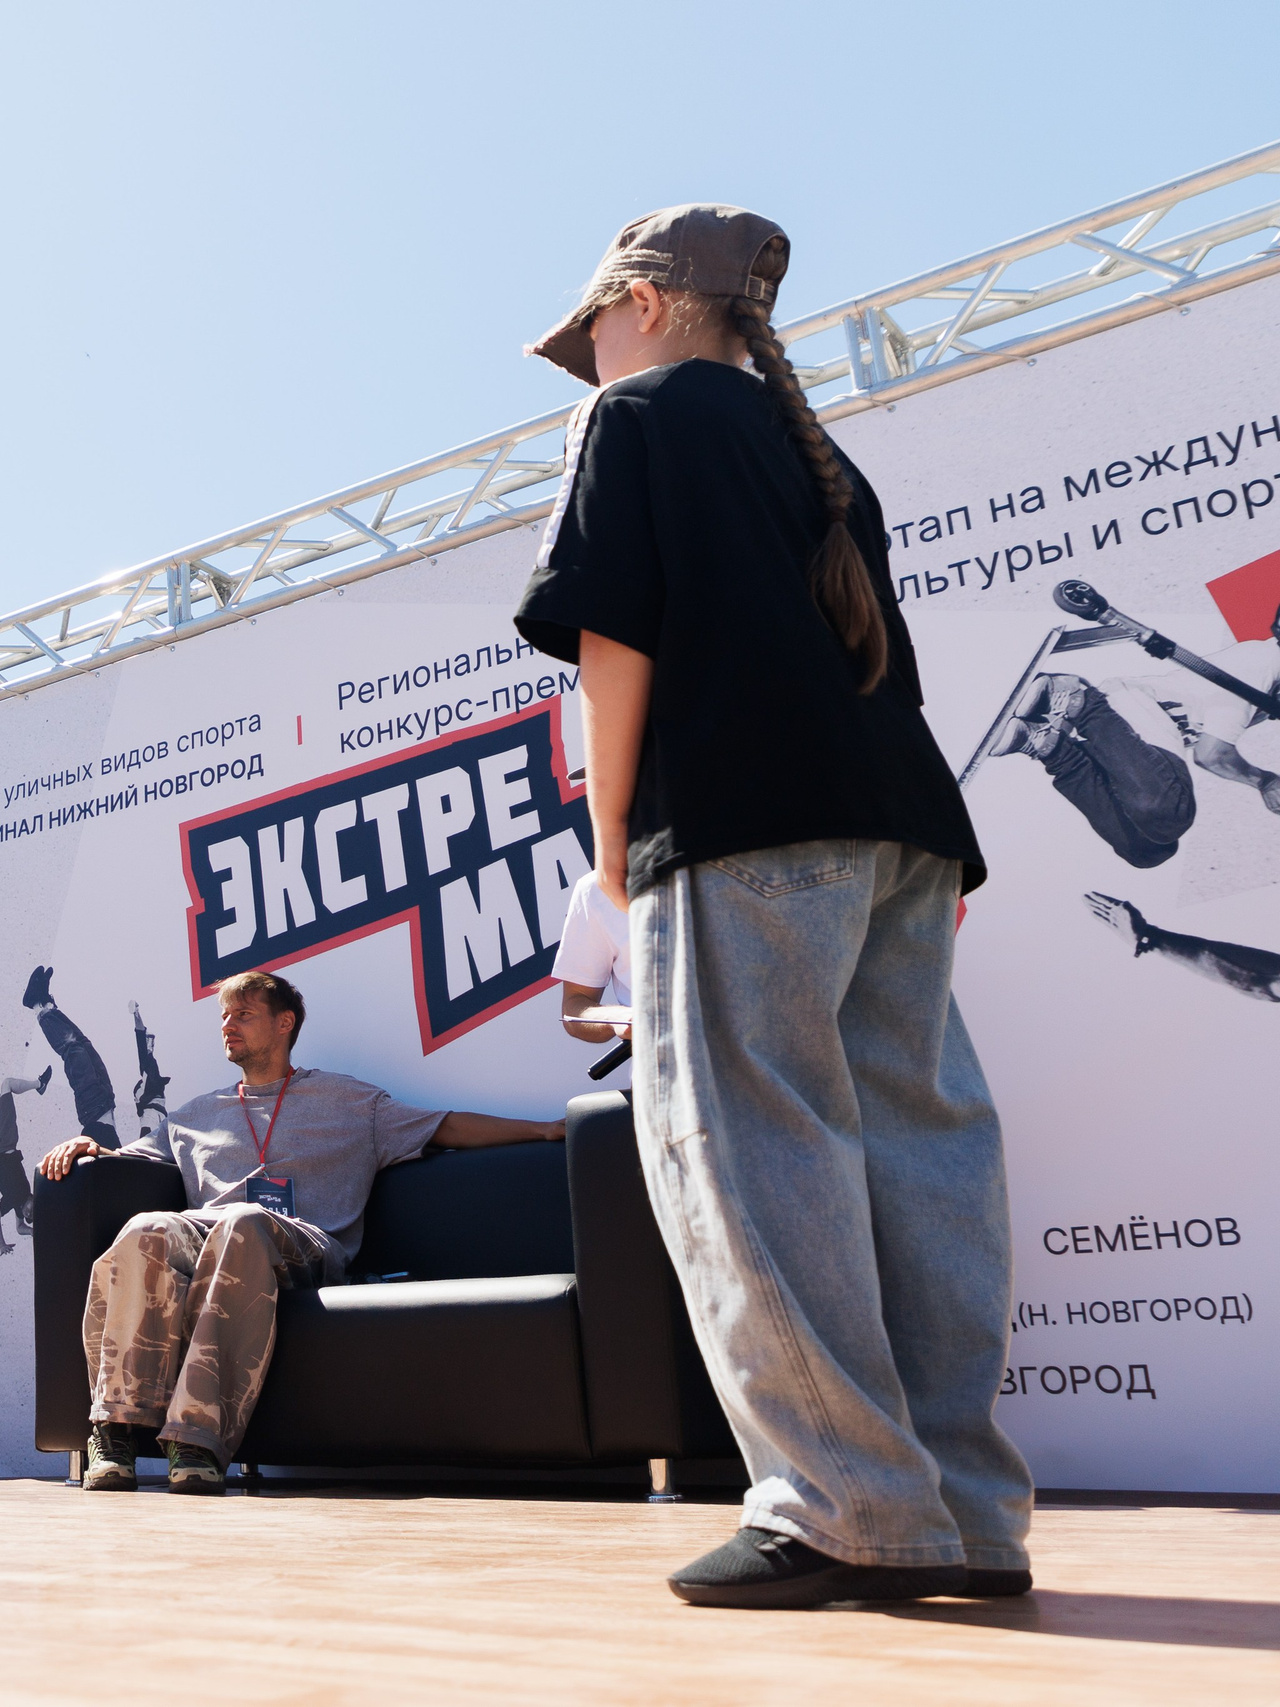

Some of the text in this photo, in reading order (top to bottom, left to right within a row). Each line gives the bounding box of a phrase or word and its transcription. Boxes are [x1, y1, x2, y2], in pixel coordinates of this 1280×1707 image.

[989, 486, 1046, 523] на
[1064, 415, 1280, 502] междун
[1092, 519, 1122, 550] и
[1141, 473, 1280, 537] спор
[338, 637, 544, 710] Региональн
[340, 668, 581, 754] конкурс-прем
[4, 763, 93, 809] уличных
[101, 741, 169, 776] видов
[177, 713, 262, 747] спорта
[49, 784, 139, 830] НИЖНИЙ
[144, 753, 265, 803] НОВГОРОД
[209, 744, 542, 959] ЭКСТРЕ
[1043, 1215, 1241, 1255] СЕМЁНОВ
[1011, 1293, 1253, 1332] (Н. НОВГОРОД)
